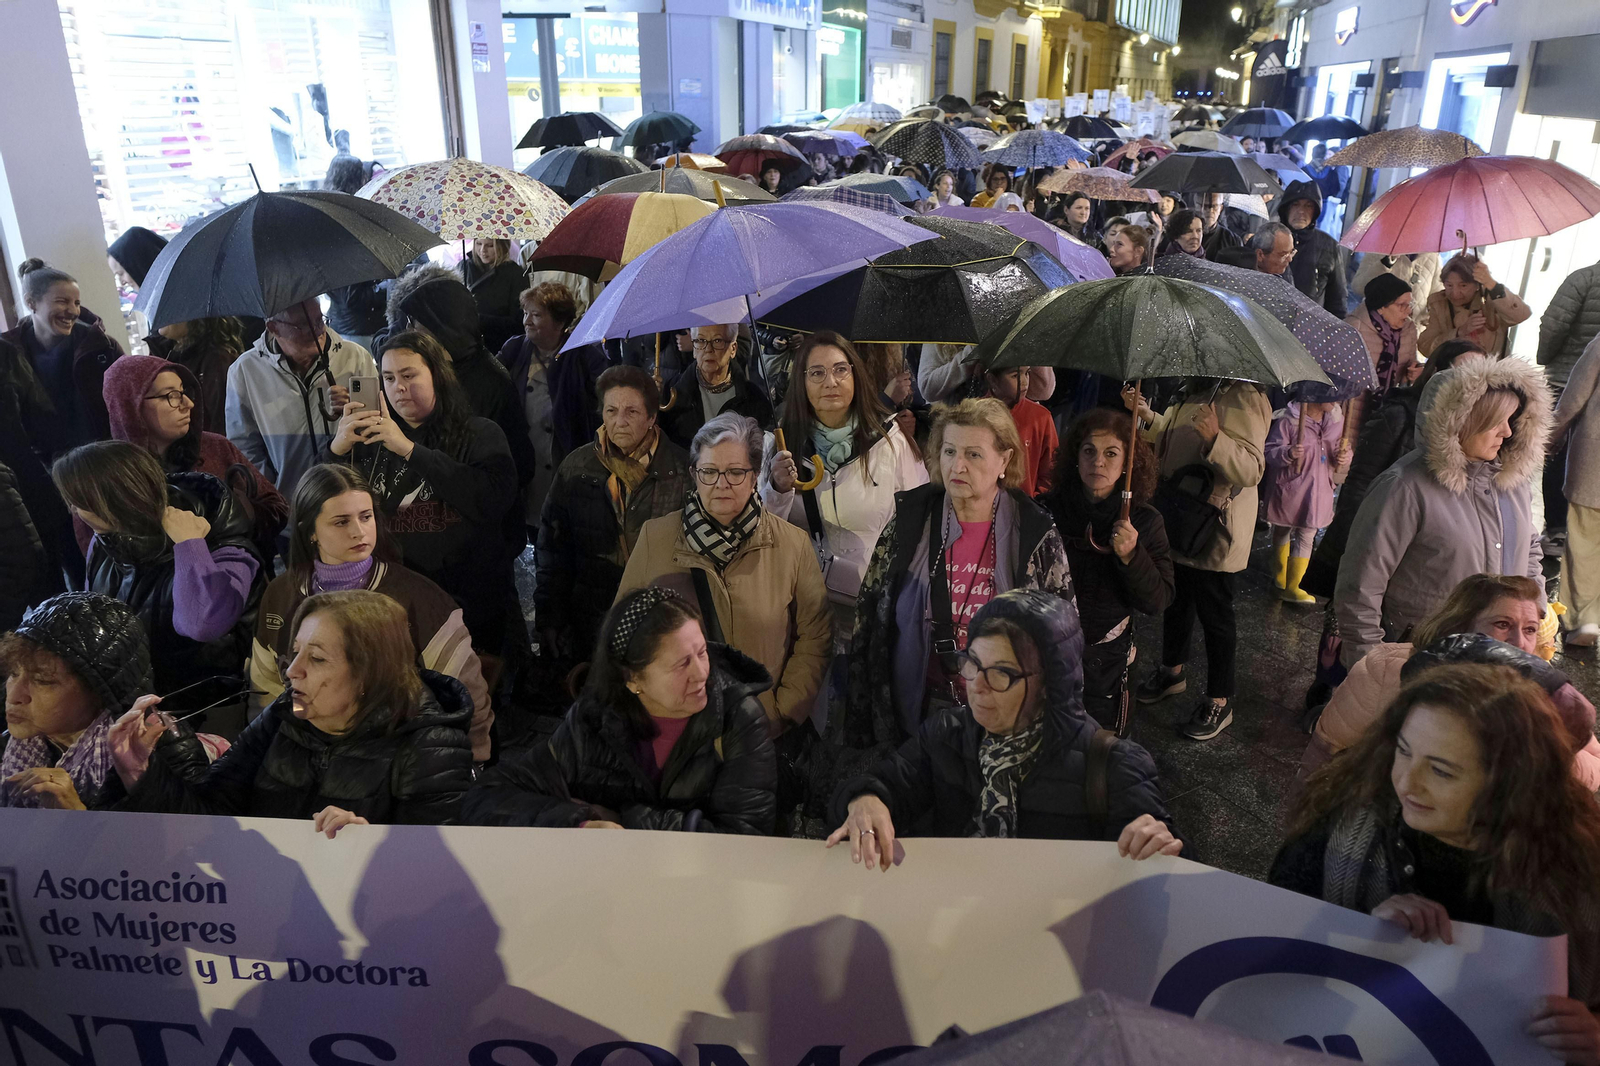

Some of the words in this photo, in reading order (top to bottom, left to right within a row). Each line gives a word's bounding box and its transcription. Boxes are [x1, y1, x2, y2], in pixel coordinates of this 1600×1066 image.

[1256, 66, 1286, 78] adidas
[33, 869, 227, 905] Asociación
[39, 909, 82, 937] de
[93, 911, 237, 947] Mujeres
[48, 945, 183, 976] Palmete
[194, 958, 218, 985] y
[229, 954, 274, 982] La
[286, 957, 430, 988] Doctora
